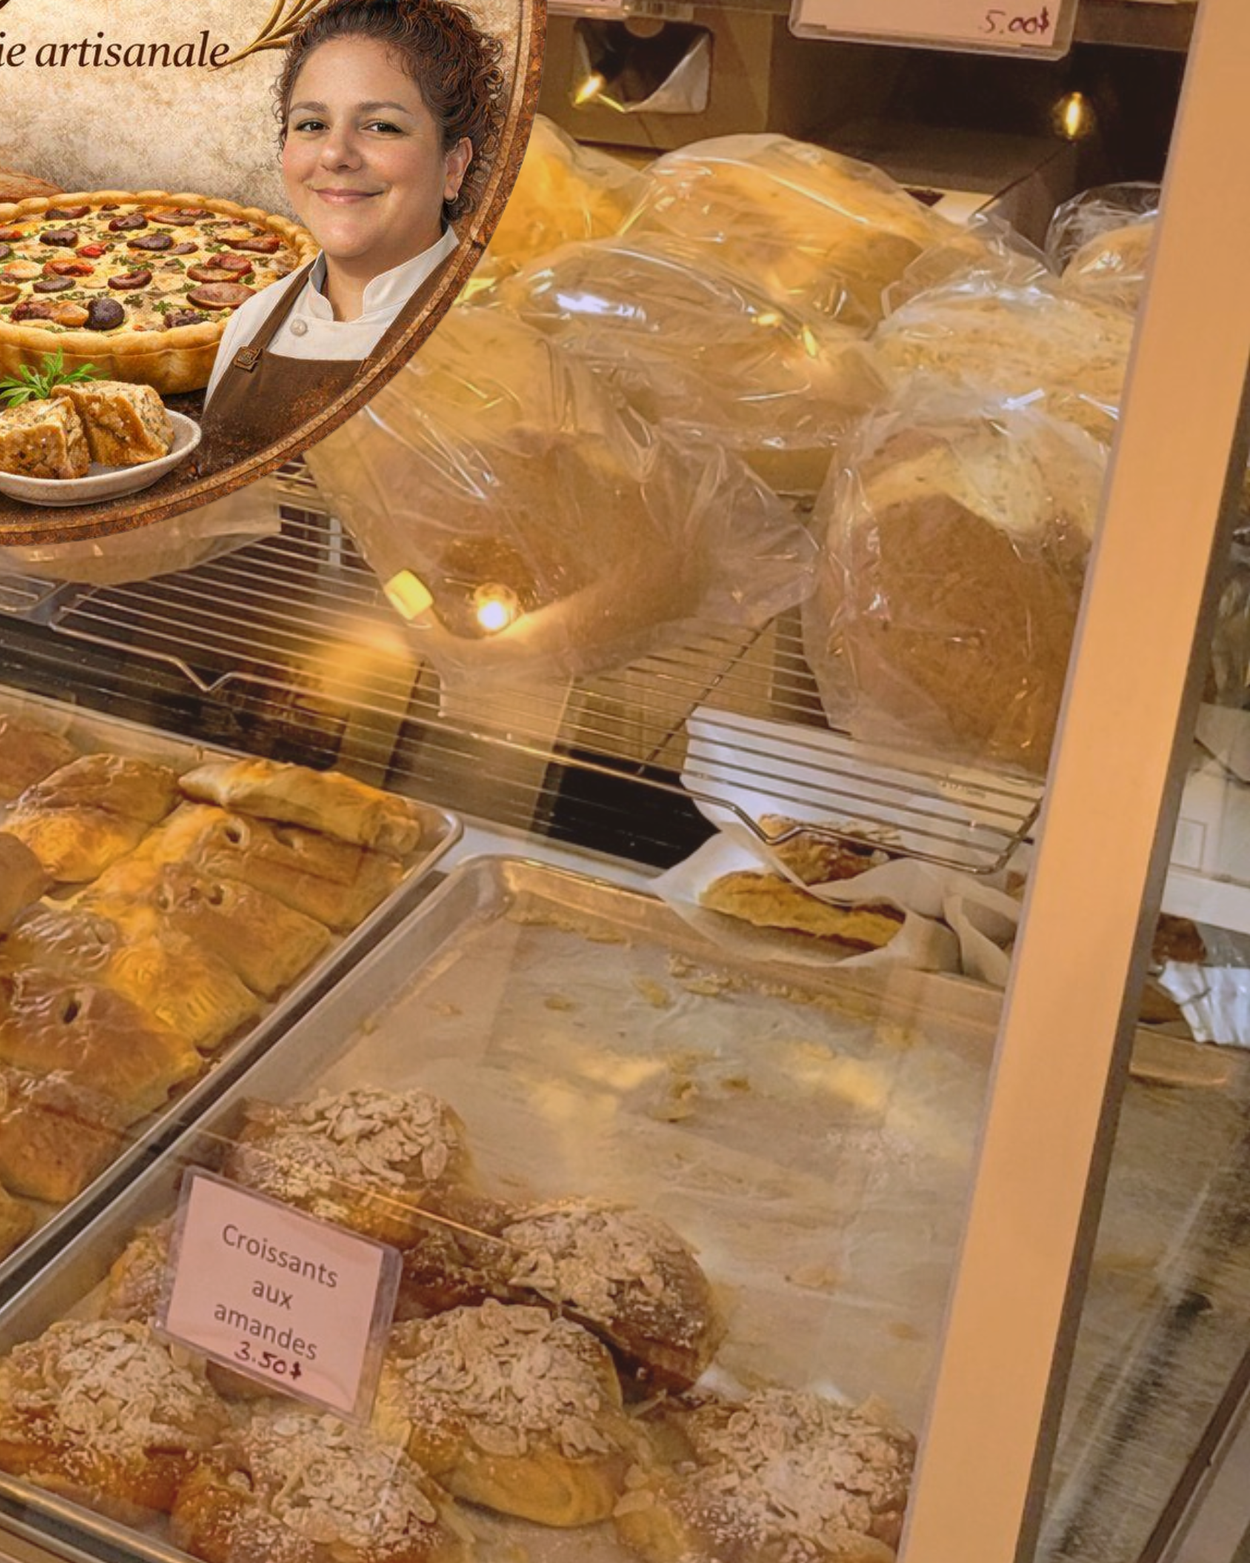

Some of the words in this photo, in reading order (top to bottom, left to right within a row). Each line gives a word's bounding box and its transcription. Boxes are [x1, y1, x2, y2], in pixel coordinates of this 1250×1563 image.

[222, 1224, 338, 1288] Croissants
[251, 1280, 294, 1310] aux
[214, 1303, 318, 1361] amandes
[234, 1341, 302, 1380] 3.50$
